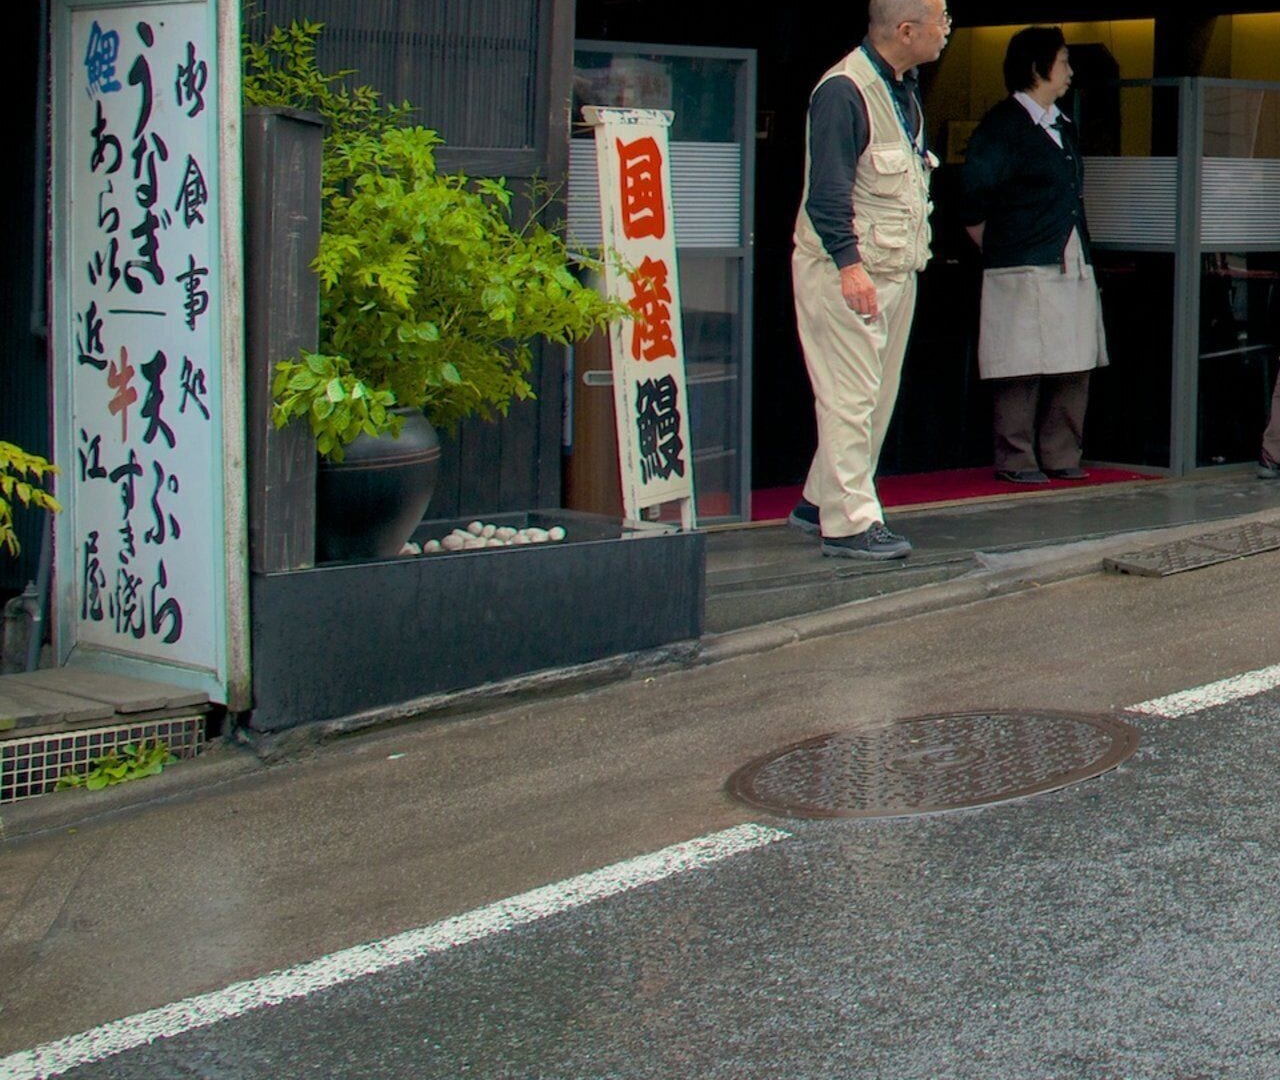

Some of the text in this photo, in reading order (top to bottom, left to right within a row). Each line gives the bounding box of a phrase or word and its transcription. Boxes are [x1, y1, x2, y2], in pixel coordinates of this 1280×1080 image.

[127, 22, 172, 294] うなぎ
[616, 135, 685, 486] 国産鰻
[141, 349, 183, 645] 天ぷら
